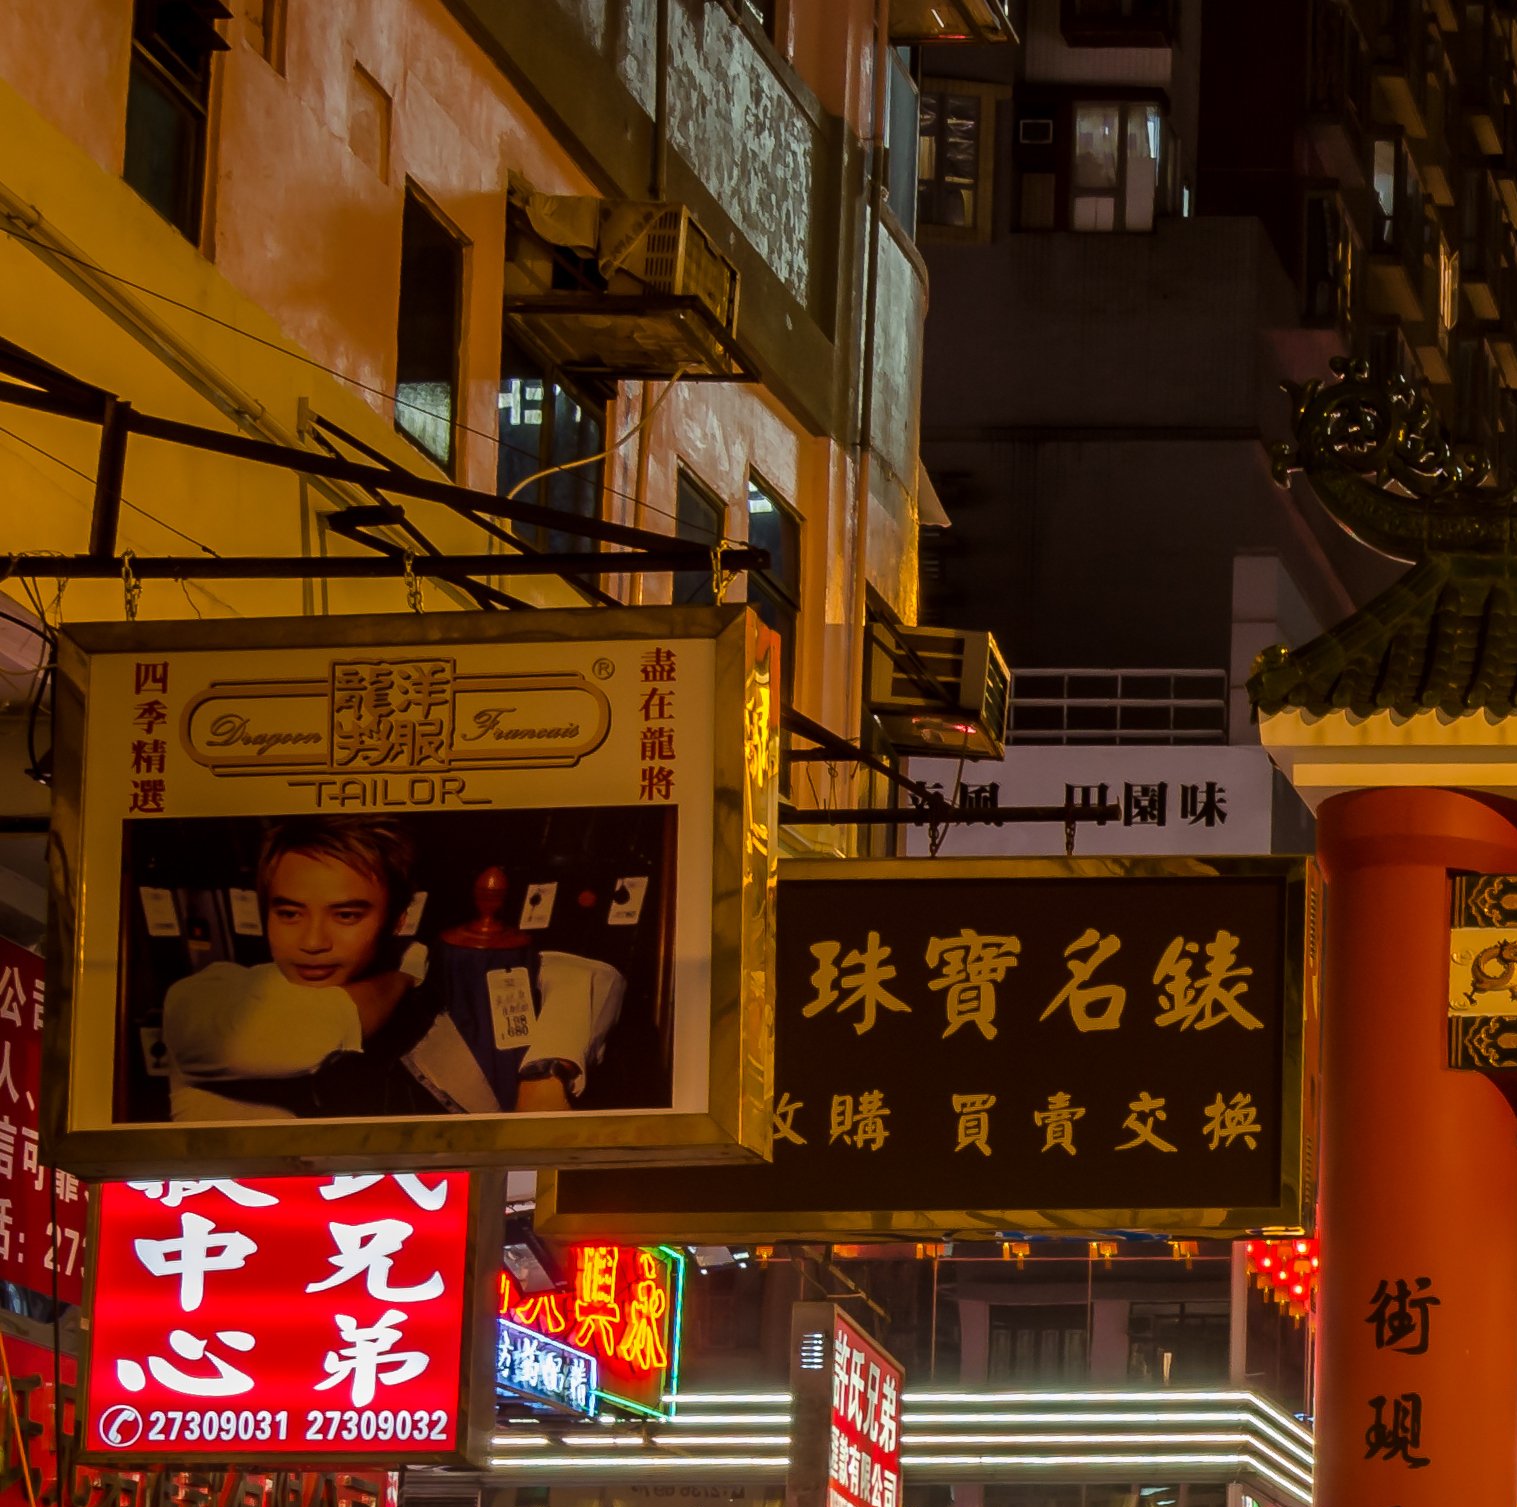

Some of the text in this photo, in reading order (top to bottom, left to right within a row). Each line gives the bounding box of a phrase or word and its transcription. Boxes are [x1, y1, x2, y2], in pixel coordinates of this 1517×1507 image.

[129, 661, 170, 813] 四季精選
[638, 647, 677, 801] 盡在龍將
[288, 776, 492, 808] TAILOR
[801, 927, 1264, 1041] 珠寶名錶
[148, 1410, 447, 1441] 27309031 27309032
[833, 1330, 898, 1453] 許氏兄弟
